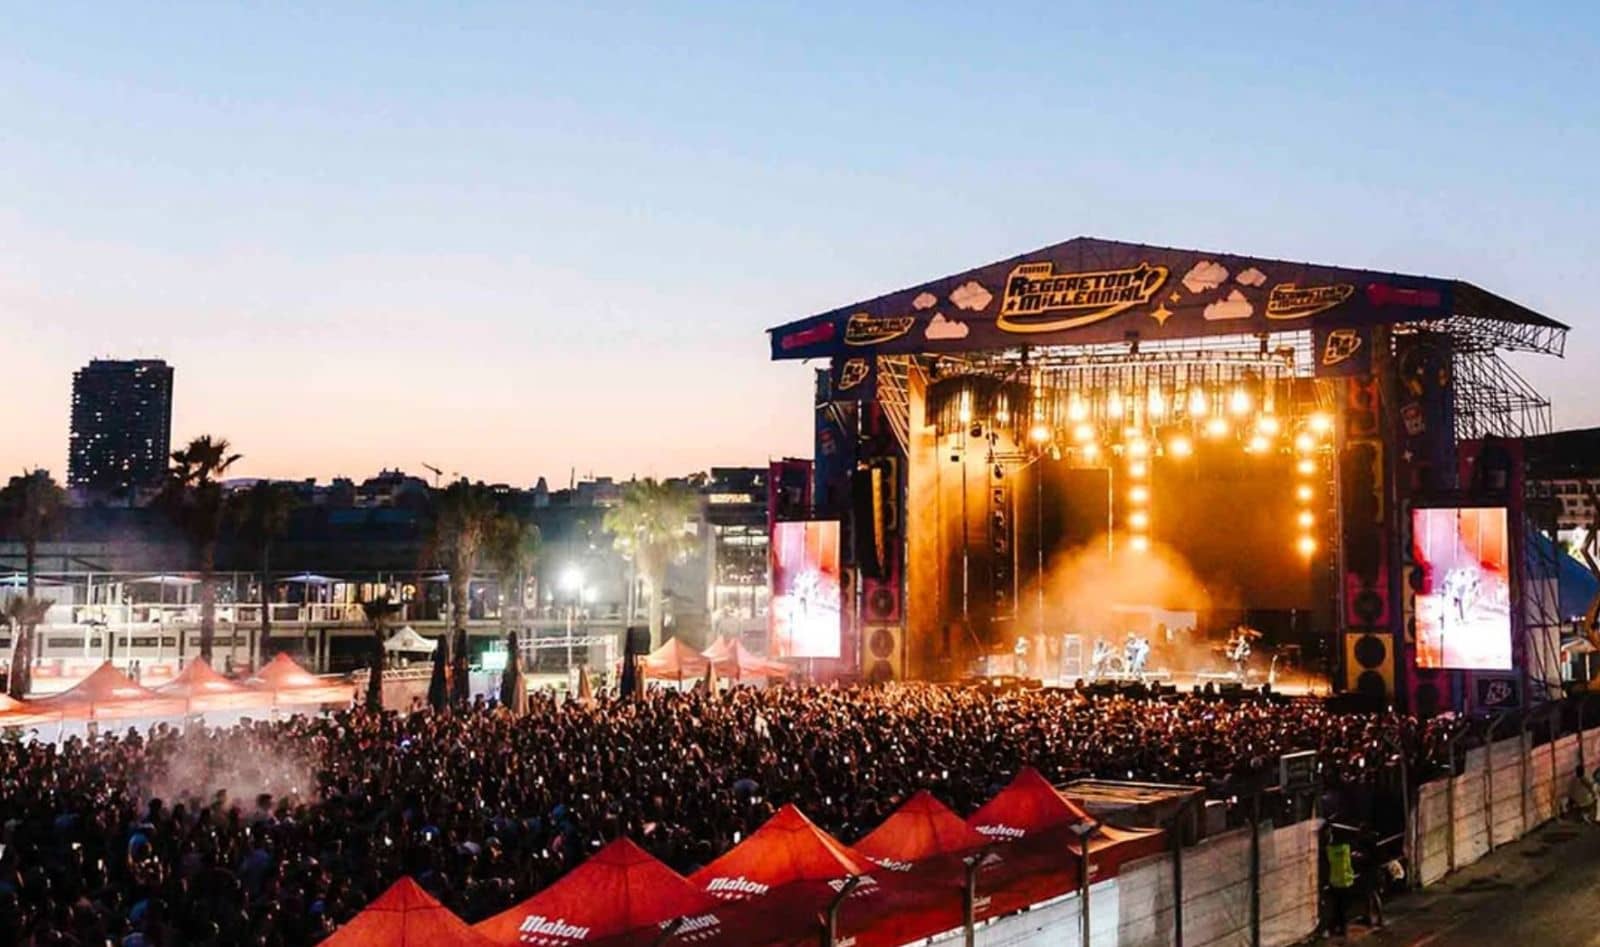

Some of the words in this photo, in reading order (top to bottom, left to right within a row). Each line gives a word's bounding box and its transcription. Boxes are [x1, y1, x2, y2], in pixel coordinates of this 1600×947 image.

[1009, 273, 1129, 295] REGGAETON
[705, 876, 769, 895] Mahou
[519, 915, 590, 939] Mahou
